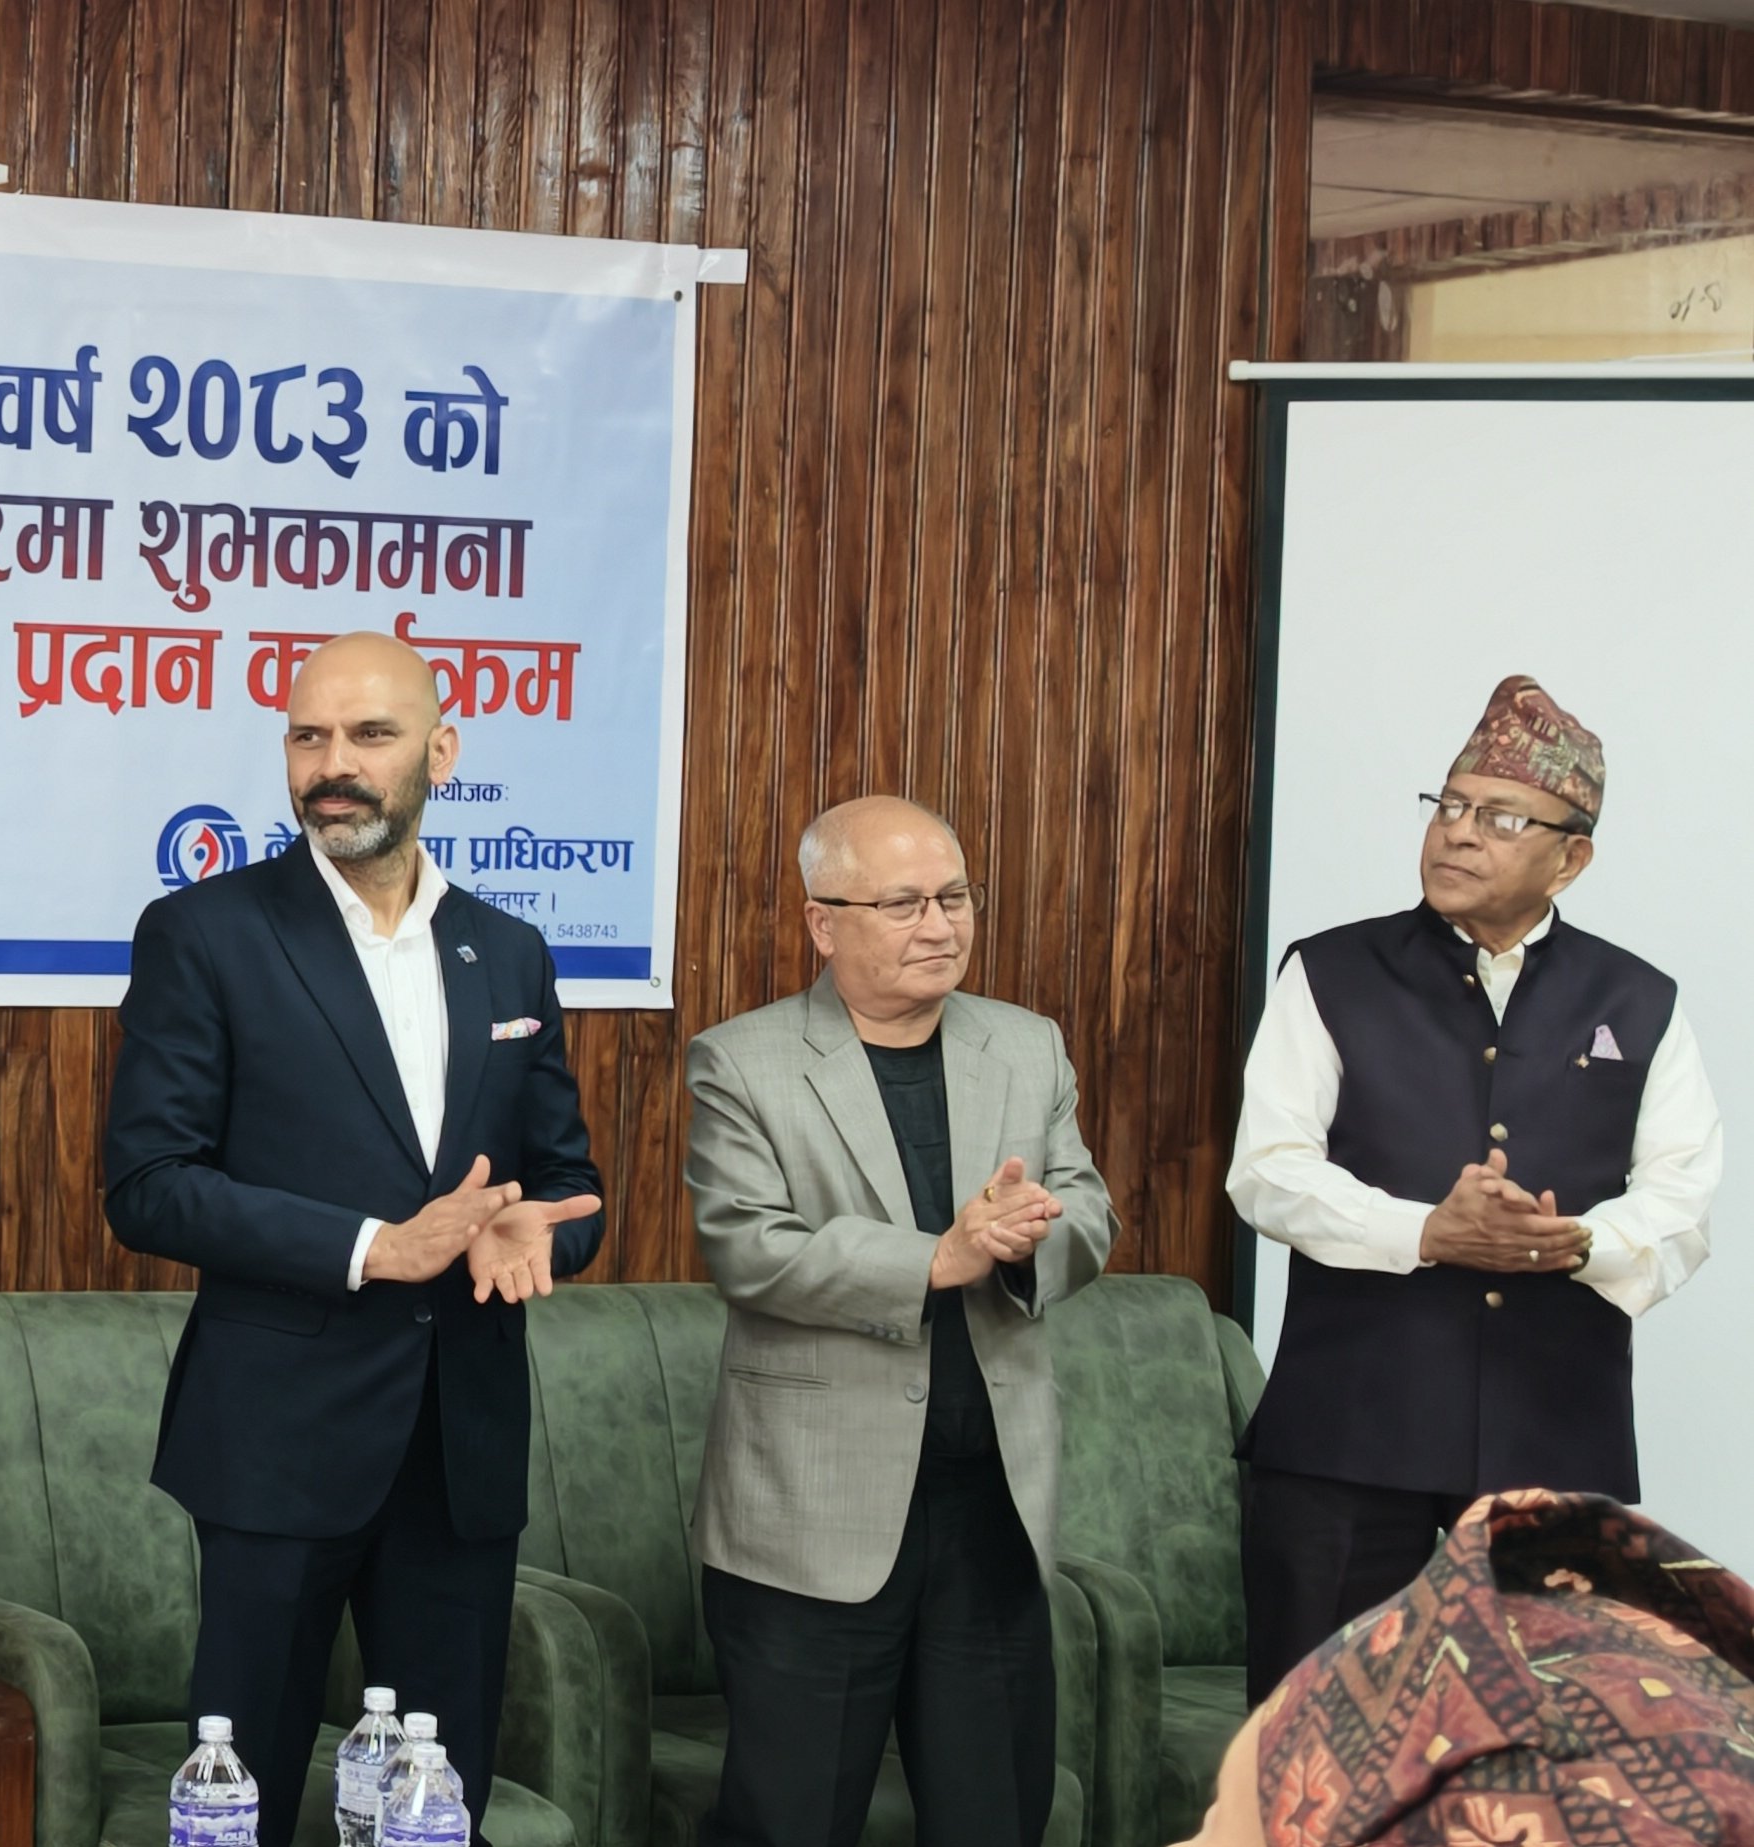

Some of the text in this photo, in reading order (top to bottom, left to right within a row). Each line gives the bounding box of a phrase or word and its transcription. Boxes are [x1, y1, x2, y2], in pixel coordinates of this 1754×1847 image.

[128, 356, 367, 479] २०८३
[404, 366, 509, 476] को
[139, 500, 534, 612] शुभकामना
[14, 621, 223, 719] प्रदान
[468, 825, 635, 875] प्राधिकरण
[556, 923, 618, 939] 5438743
